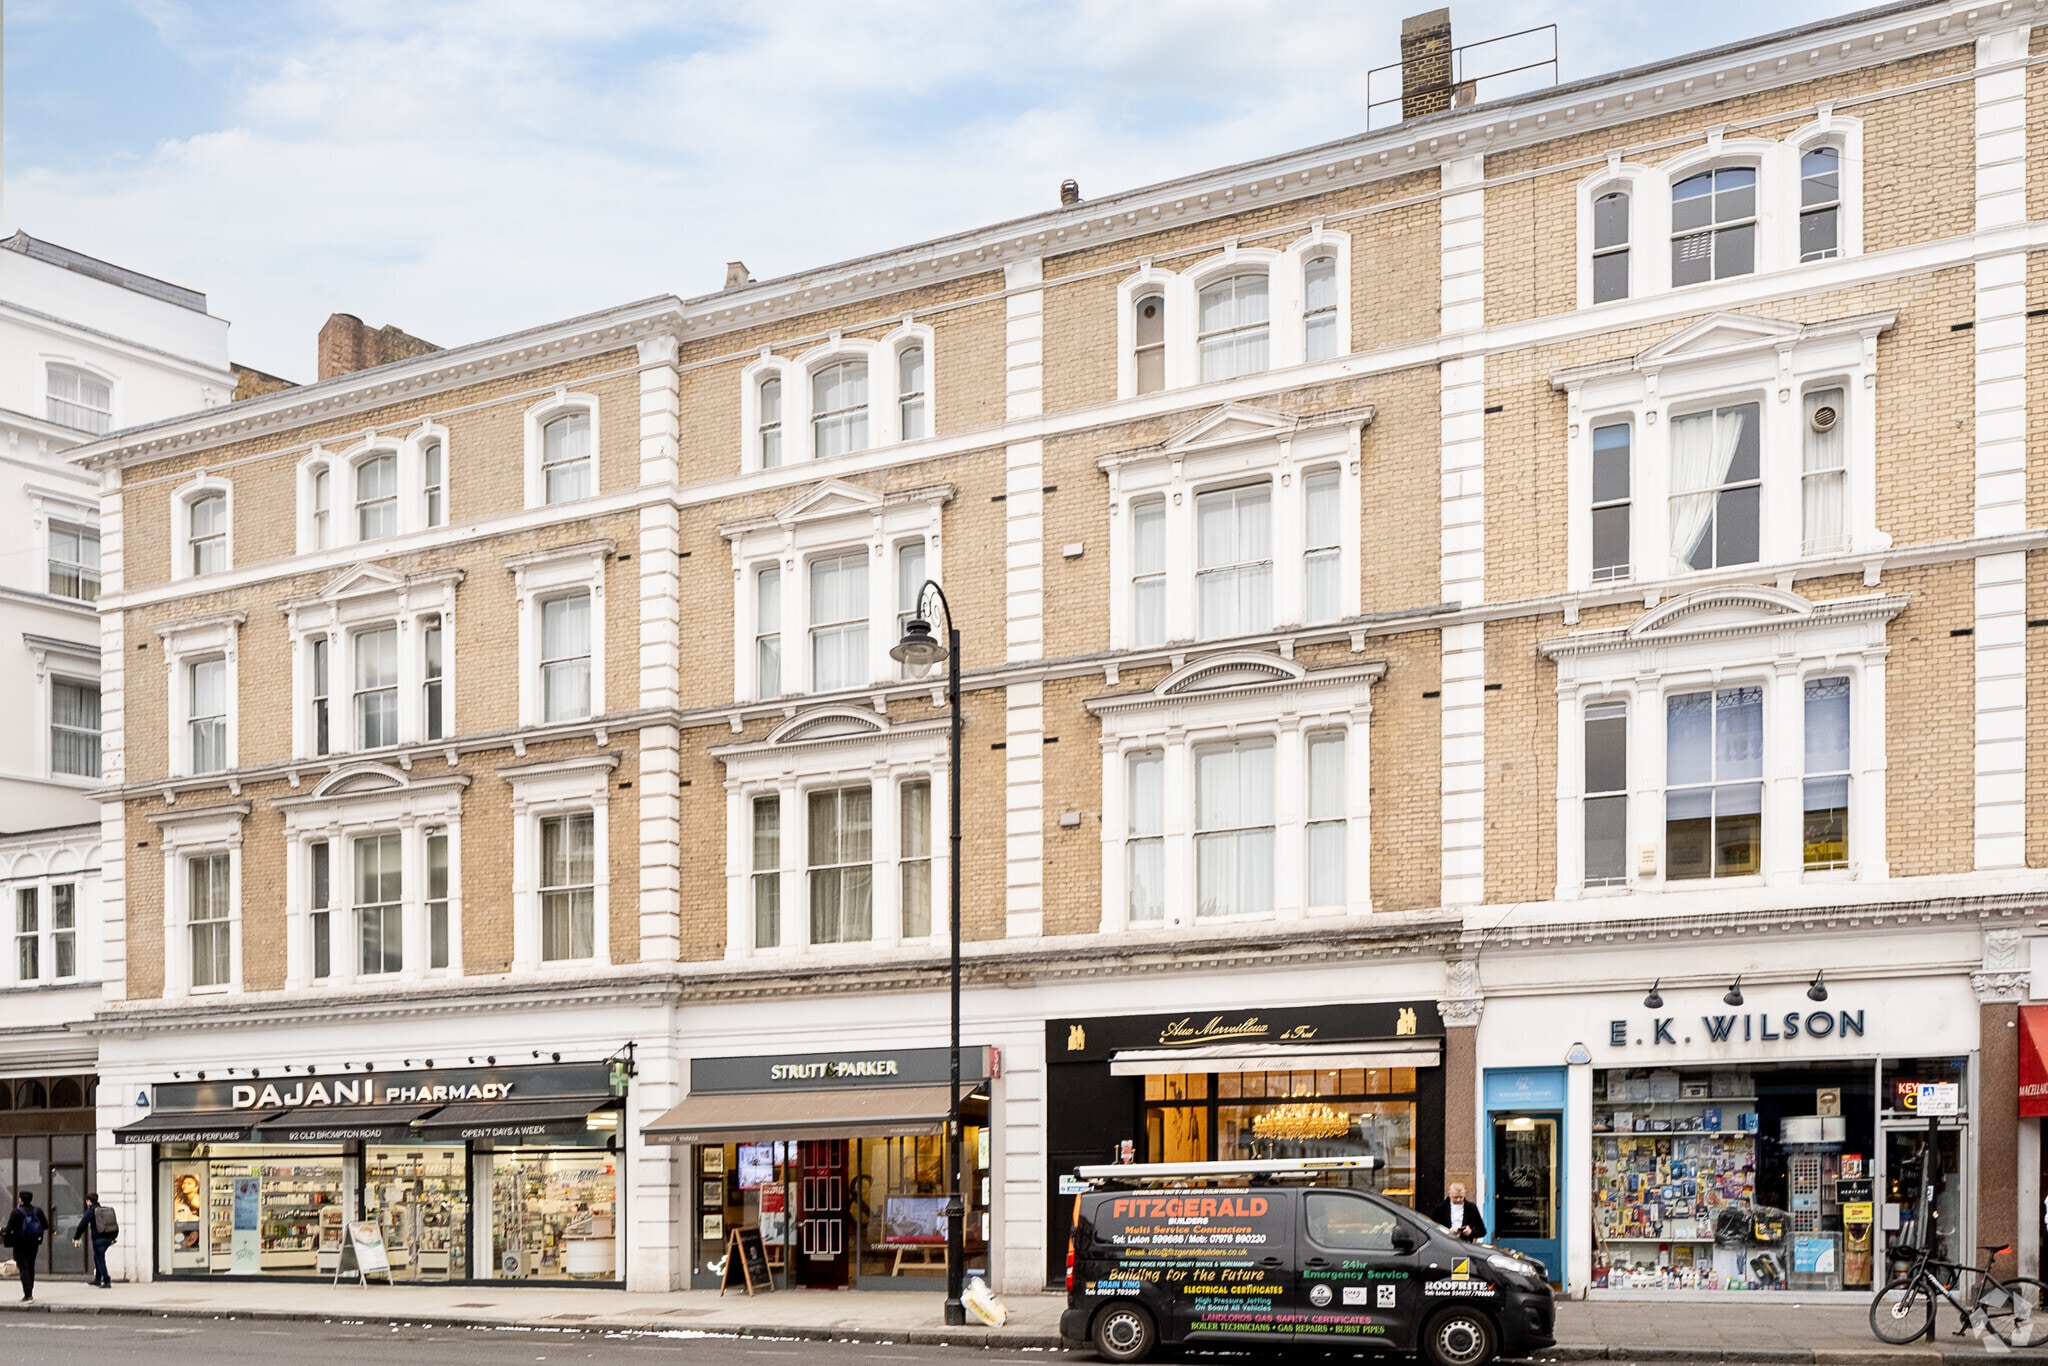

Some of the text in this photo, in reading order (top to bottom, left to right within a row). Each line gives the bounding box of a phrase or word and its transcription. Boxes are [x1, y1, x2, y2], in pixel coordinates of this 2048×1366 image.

[1162, 1017, 1194, 1038] Aux
[1194, 1016, 1269, 1037] Merveilleux
[1290, 1025, 1317, 1040] Fred
[1701, 1009, 1865, 1042] WILSON
[1898, 1082, 1918, 1094] KEY
[232, 1079, 514, 1109] DAJANI PHARMACY
[125, 1134, 161, 1143] EXCLUSIVE
[161, 1133, 195, 1142] SKINCARE
[202, 1131, 240, 1140] PERFUMES
[289, 1129, 381, 1140] 92 OLD BROMPTON ROAD
[461, 1128, 484, 1138] OPEN
[485, 1127, 491, 1136] 7
[492, 1127, 514, 1137] DAYS
[520, 1125, 545, 1136] WEEK
[1113, 1197, 1268, 1218] FITZGERALD
[1168, 1217, 1209, 1225] BUILDERS
[1125, 1225, 1252, 1235] Multi Service Contractors
[1128, 1235, 1150, 1244] Luton
[1342, 1260, 1368, 1269] 24hr
[1108, 1268, 1265, 1284] Building for the Future
[1302, 1269, 1409, 1280] Emergency Service
[1097, 1280, 1141, 1289] DRAIN KING
[1183, 1285, 1284, 1295] ELECTRICAL CERTIFICATES
[1424, 1281, 1488, 1291] ROOFRITE
[1195, 1297, 1272, 1306] High Pressure Jetting
[1195, 1304, 1272, 1312] On Board All Vehicles
[1201, 1313, 1372, 1325] LANDLORDS GAS SAFETY CERTIFICATES
[1191, 1322, 1385, 1334] BOILER TECHNICIANS GAS REPAIRS BURST PIPES
